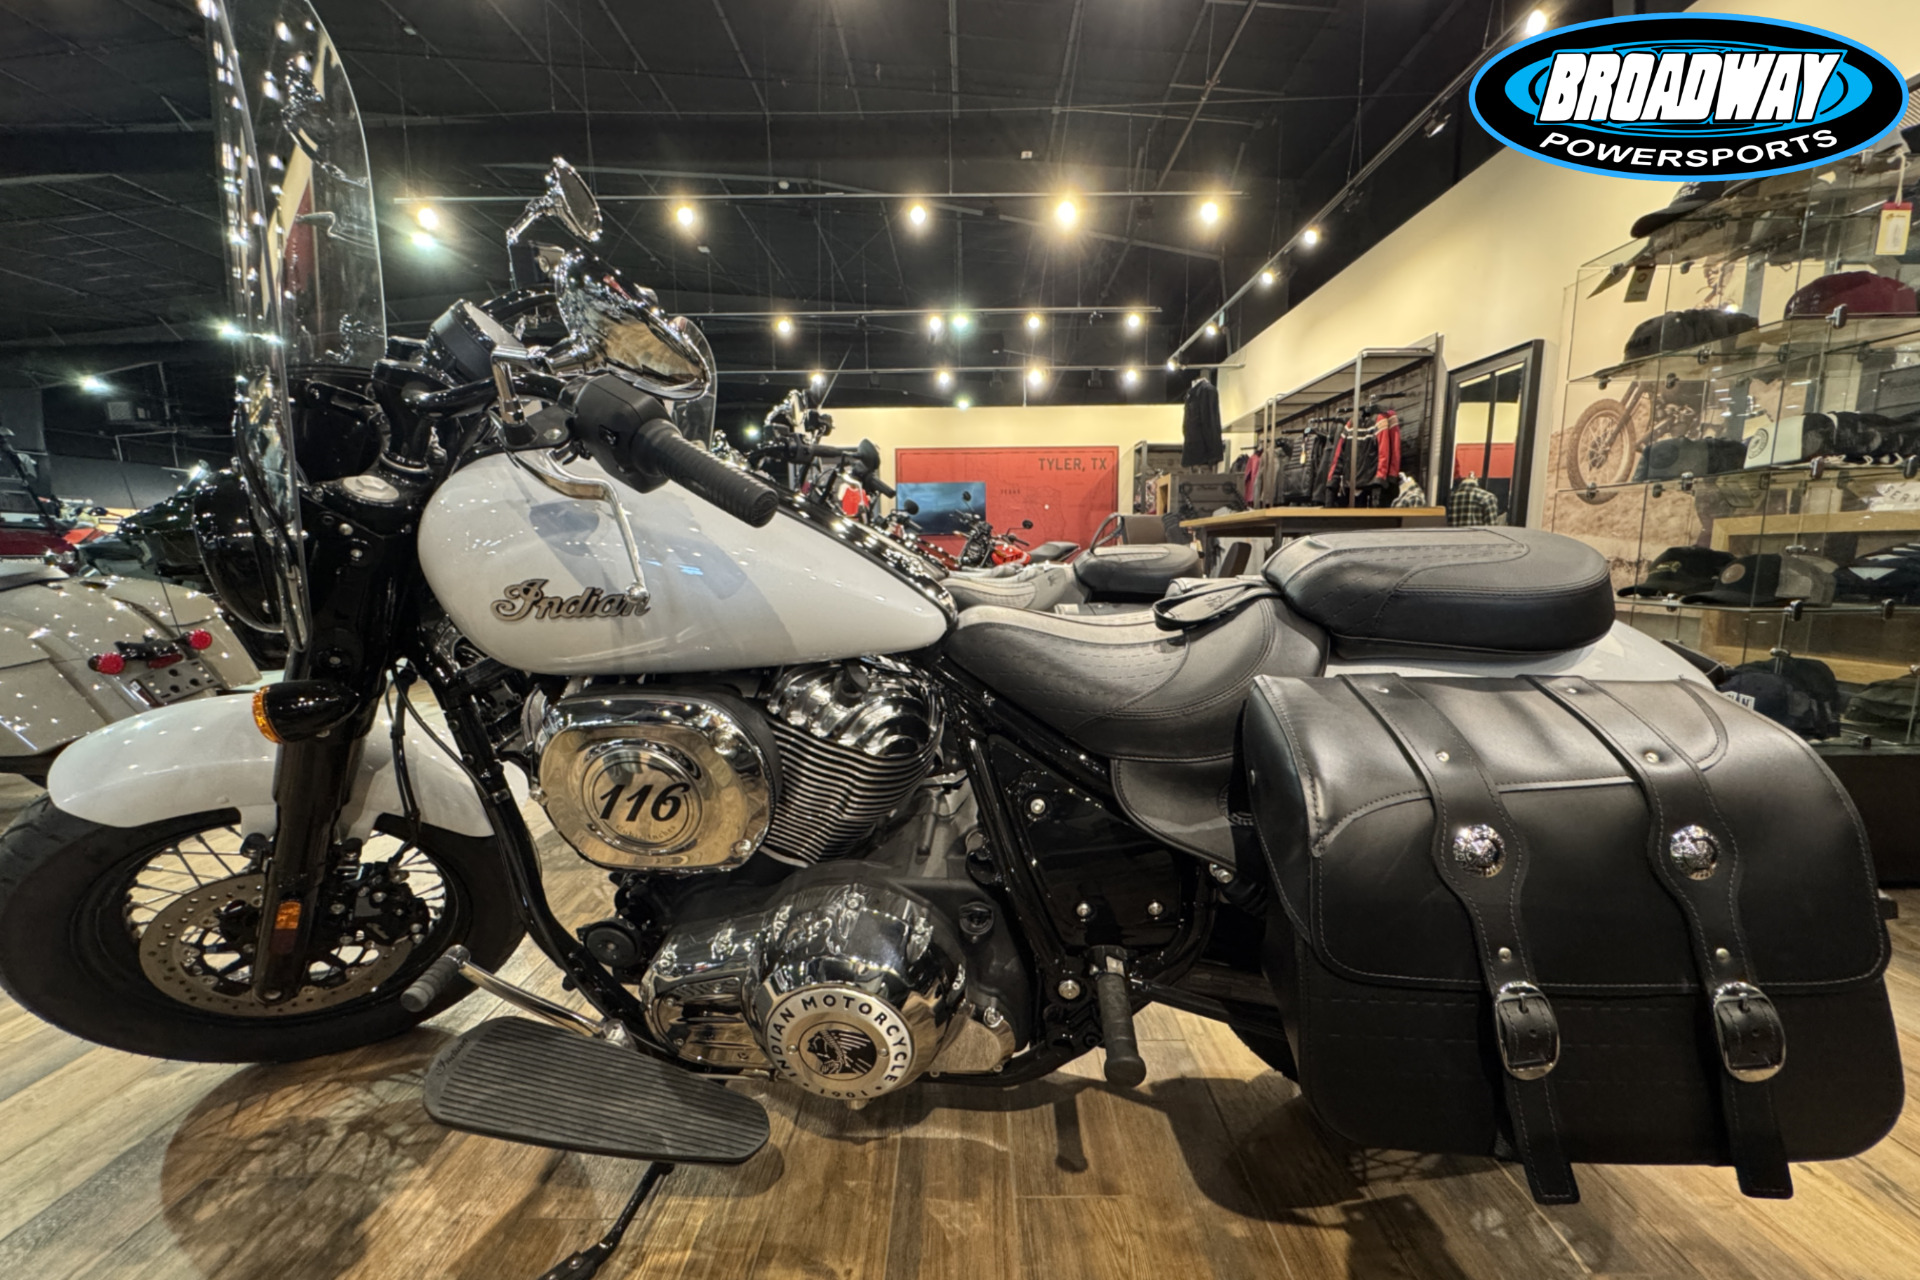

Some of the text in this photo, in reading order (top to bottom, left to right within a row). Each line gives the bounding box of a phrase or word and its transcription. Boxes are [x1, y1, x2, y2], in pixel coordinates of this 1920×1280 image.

[1038, 457, 1107, 472] TYLER, TX
[490, 578, 651, 622] Indian
[600, 782, 690, 822] 116
[770, 994, 908, 1083] INDIAN MOTORCYCLE
